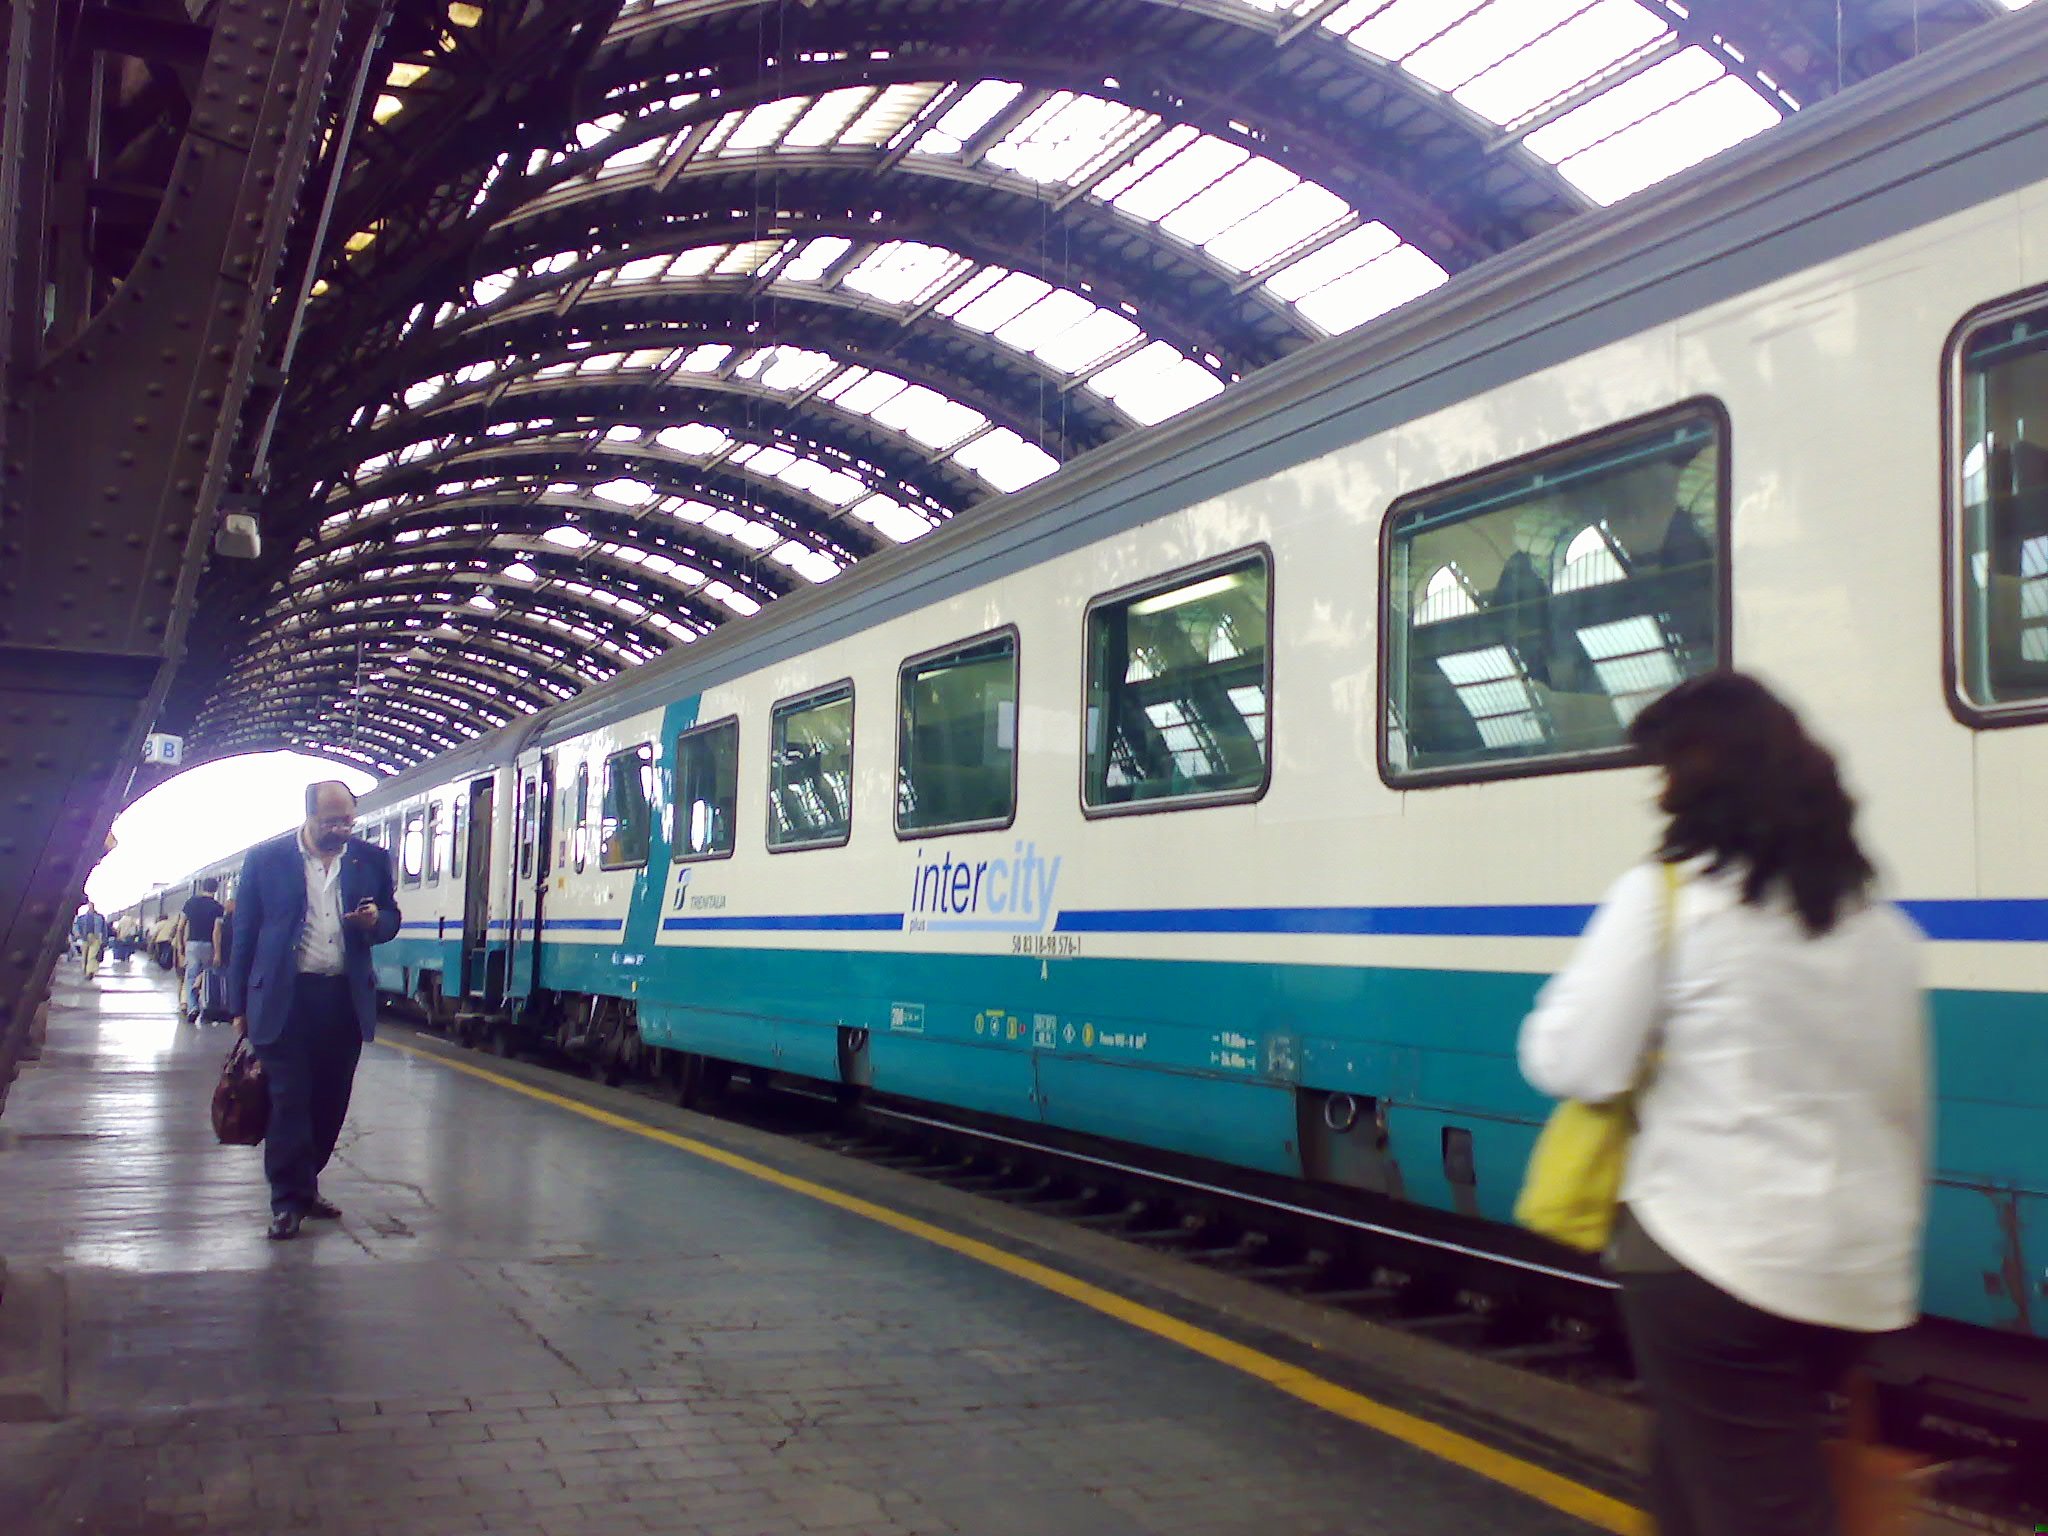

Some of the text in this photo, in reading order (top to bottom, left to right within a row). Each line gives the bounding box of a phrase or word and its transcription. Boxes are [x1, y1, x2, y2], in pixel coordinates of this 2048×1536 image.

[164, 742, 174, 757] B
[911, 840, 1062, 932] intercity
[909, 917, 926, 934] plus
